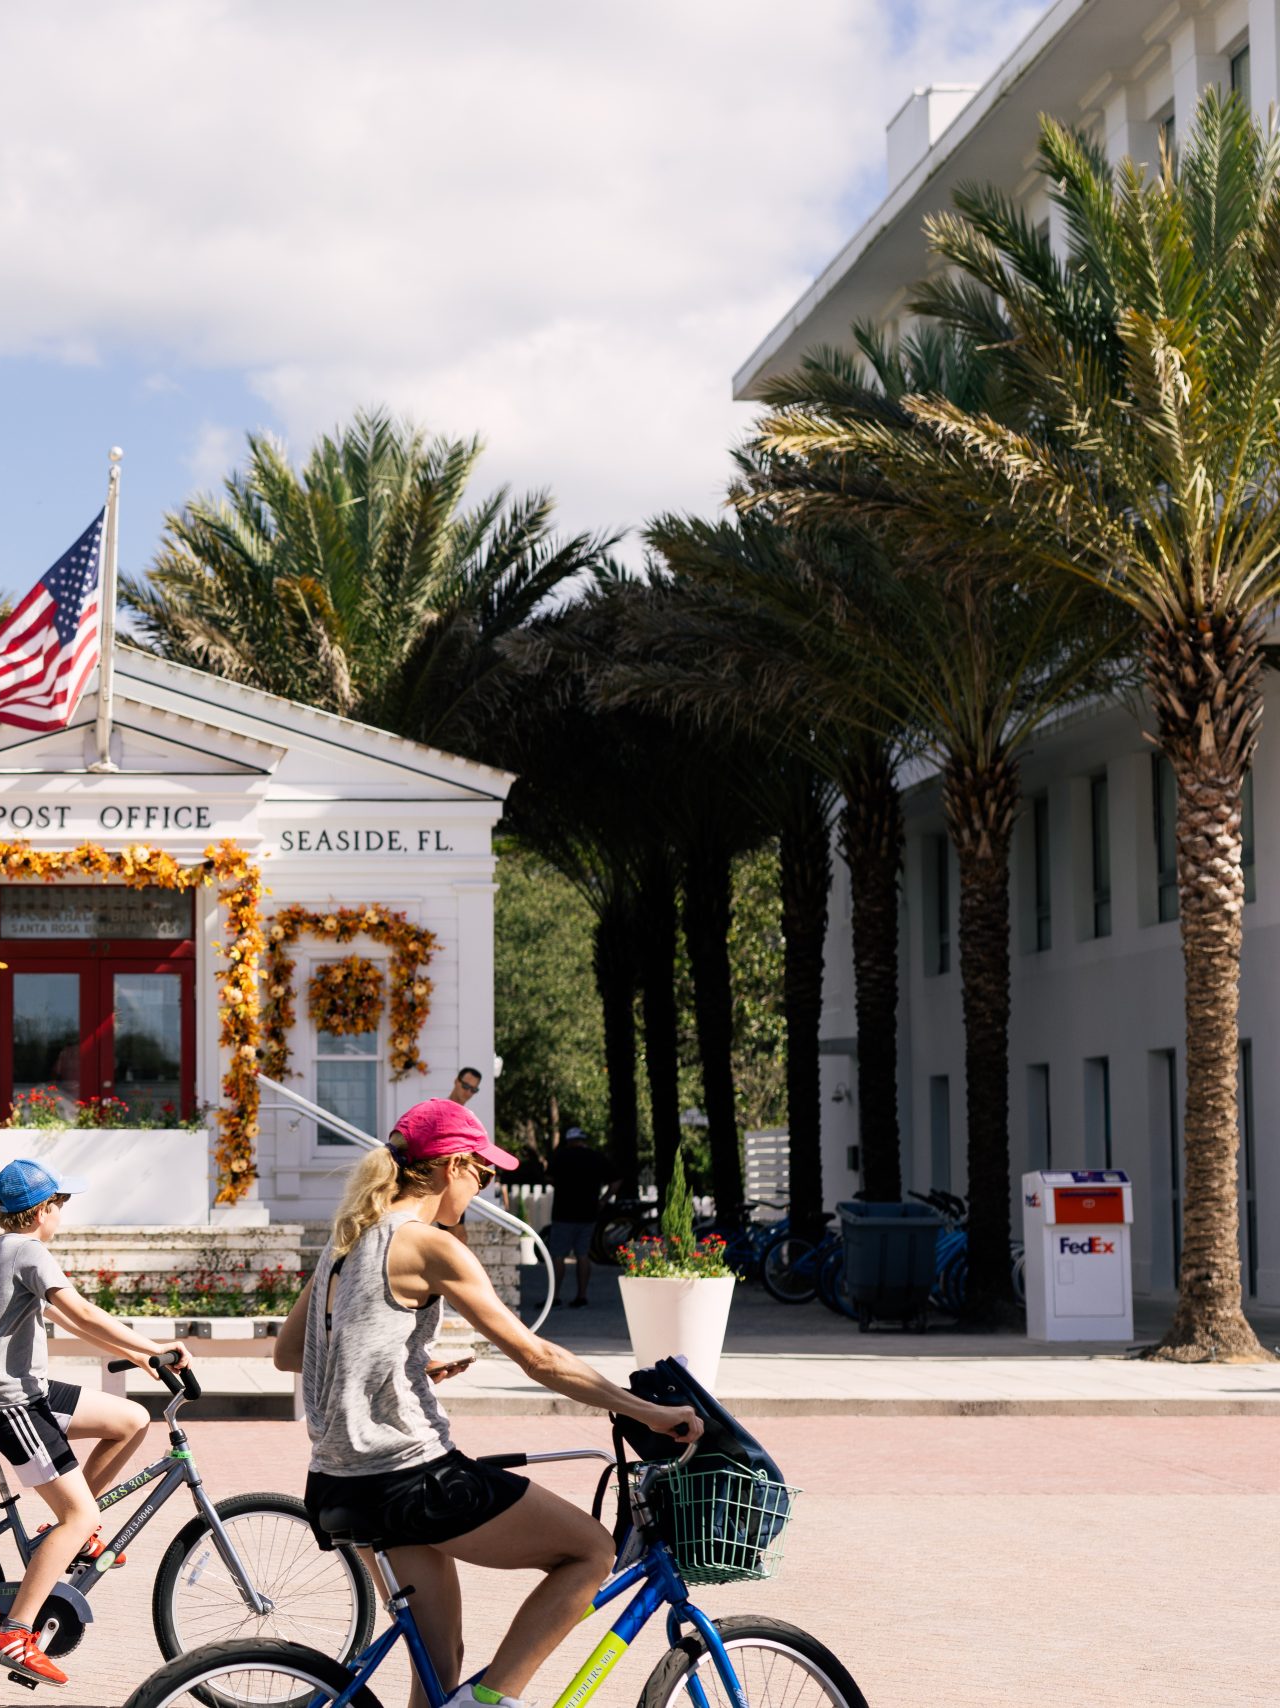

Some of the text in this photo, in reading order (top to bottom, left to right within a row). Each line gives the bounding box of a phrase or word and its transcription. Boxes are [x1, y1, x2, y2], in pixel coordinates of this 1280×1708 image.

[100, 806, 212, 829] OFFICE
[280, 829, 454, 853] SEASIDE, FL.
[11, 923, 48, 934] SANTA
[50, 923, 80, 934] ROSA
[1059, 1236, 1115, 1255] FedEx
[128, 1471, 153, 1490] 30A
[113, 1504, 154, 1552] (850)213-0040
